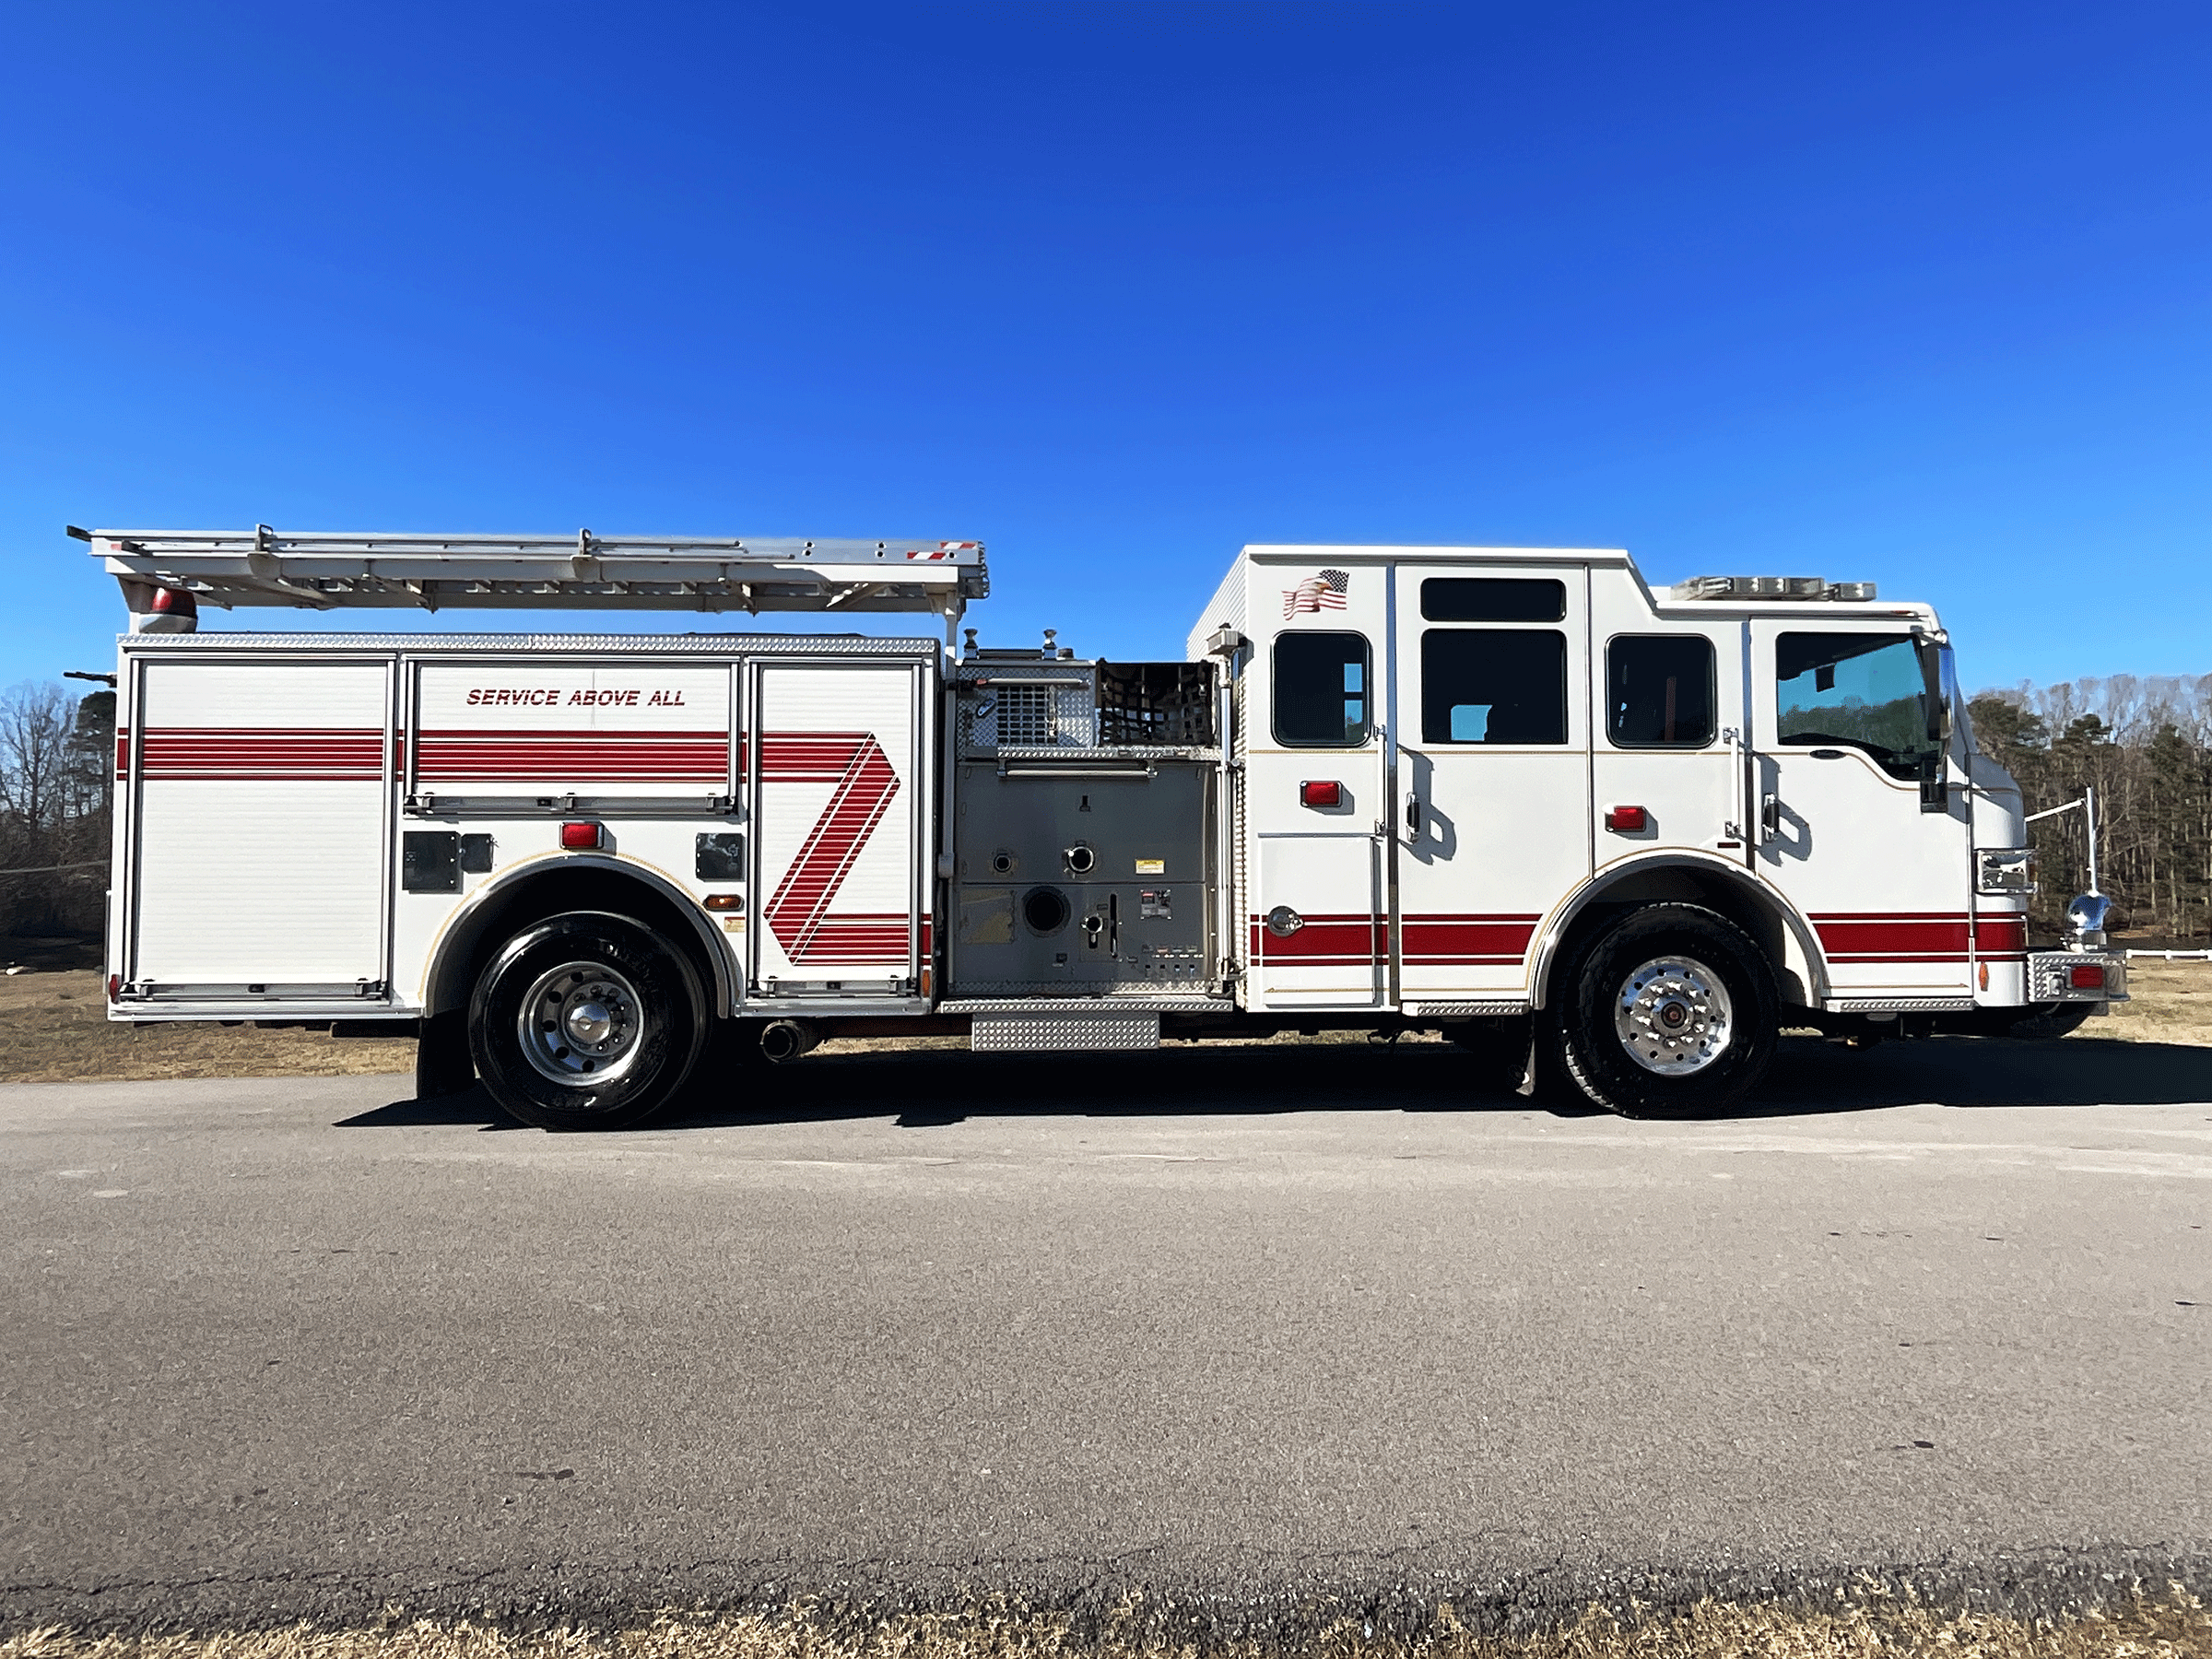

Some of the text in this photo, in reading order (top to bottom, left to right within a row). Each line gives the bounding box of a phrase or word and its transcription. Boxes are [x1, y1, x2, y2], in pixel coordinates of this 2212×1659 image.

[466, 688, 686, 706] SERVICE ABOVE ALL
